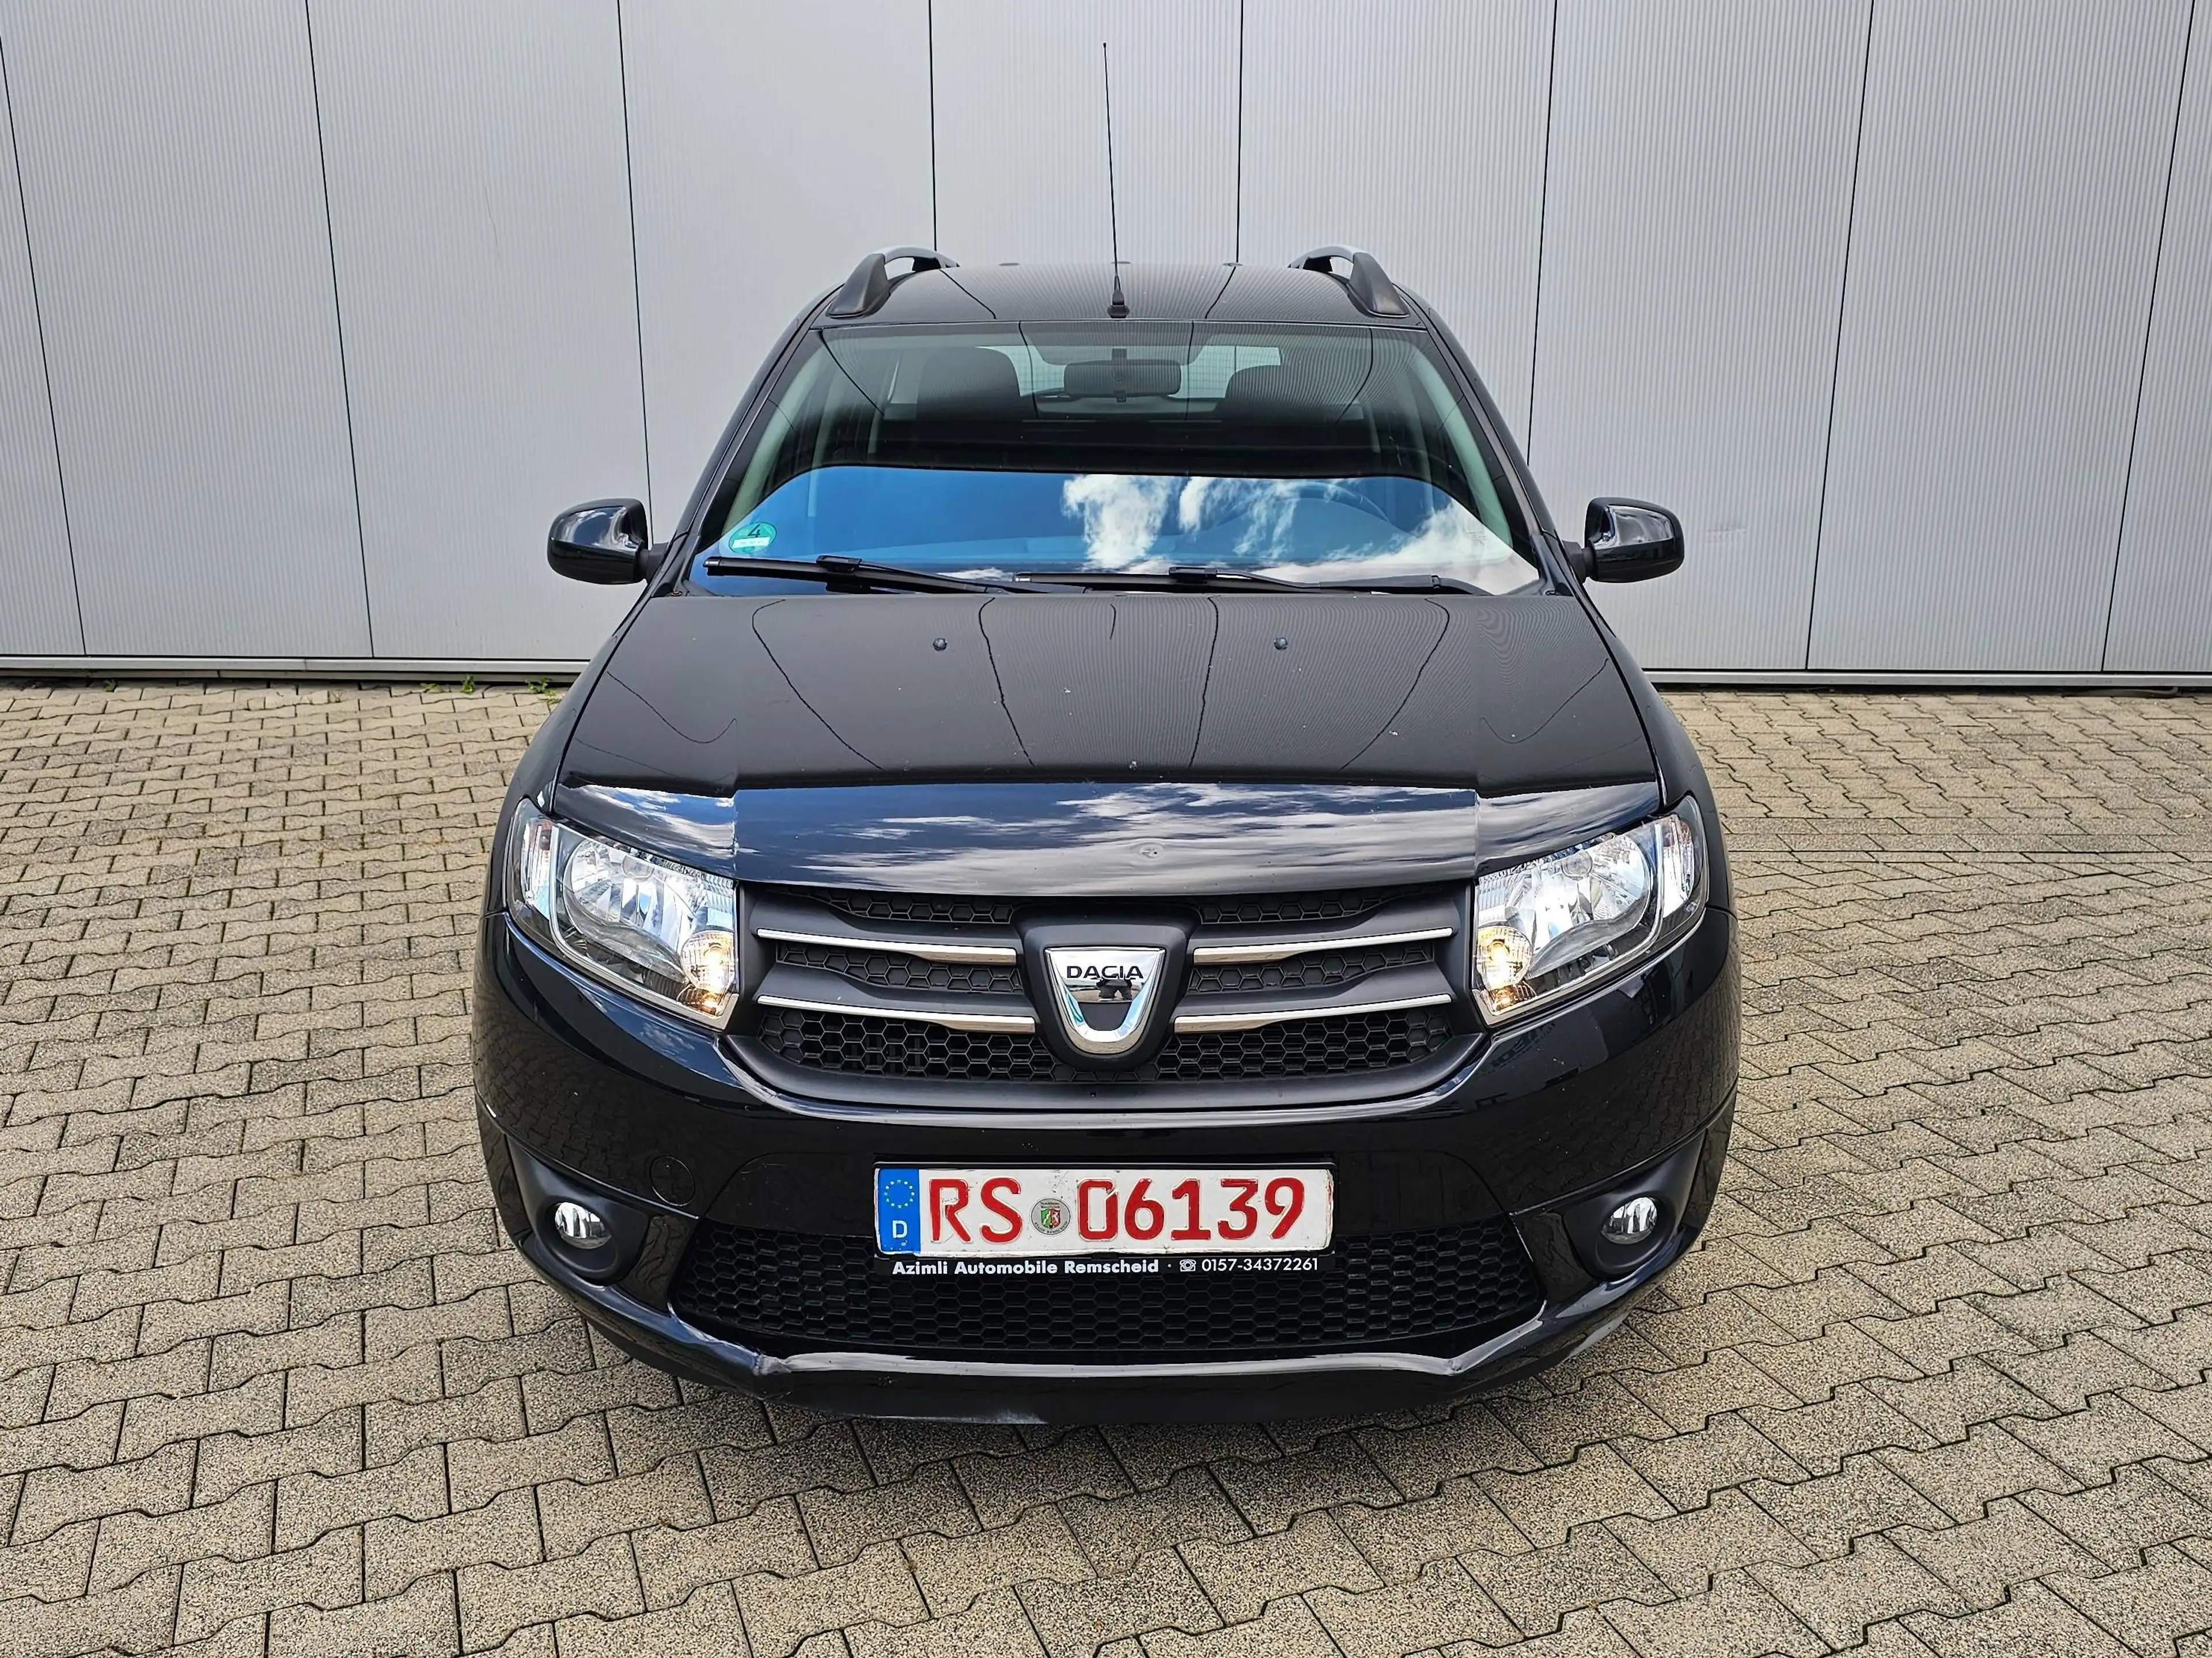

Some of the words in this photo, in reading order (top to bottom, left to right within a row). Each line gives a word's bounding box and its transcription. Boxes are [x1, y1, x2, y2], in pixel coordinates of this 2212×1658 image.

[747, 523, 761, 537] 4
[1067, 966, 1144, 979] DACIA
[929, 1177, 1024, 1243] RS
[1078, 1178, 1305, 1240] 06139
[892, 1220, 908, 1239] D
[892, 1261, 948, 1275] Azimli
[954, 1260, 1058, 1274] Automobile
[1065, 1259, 1159, 1274] Remscheid
[1202, 1258, 1317, 1272] 0157-34372261
